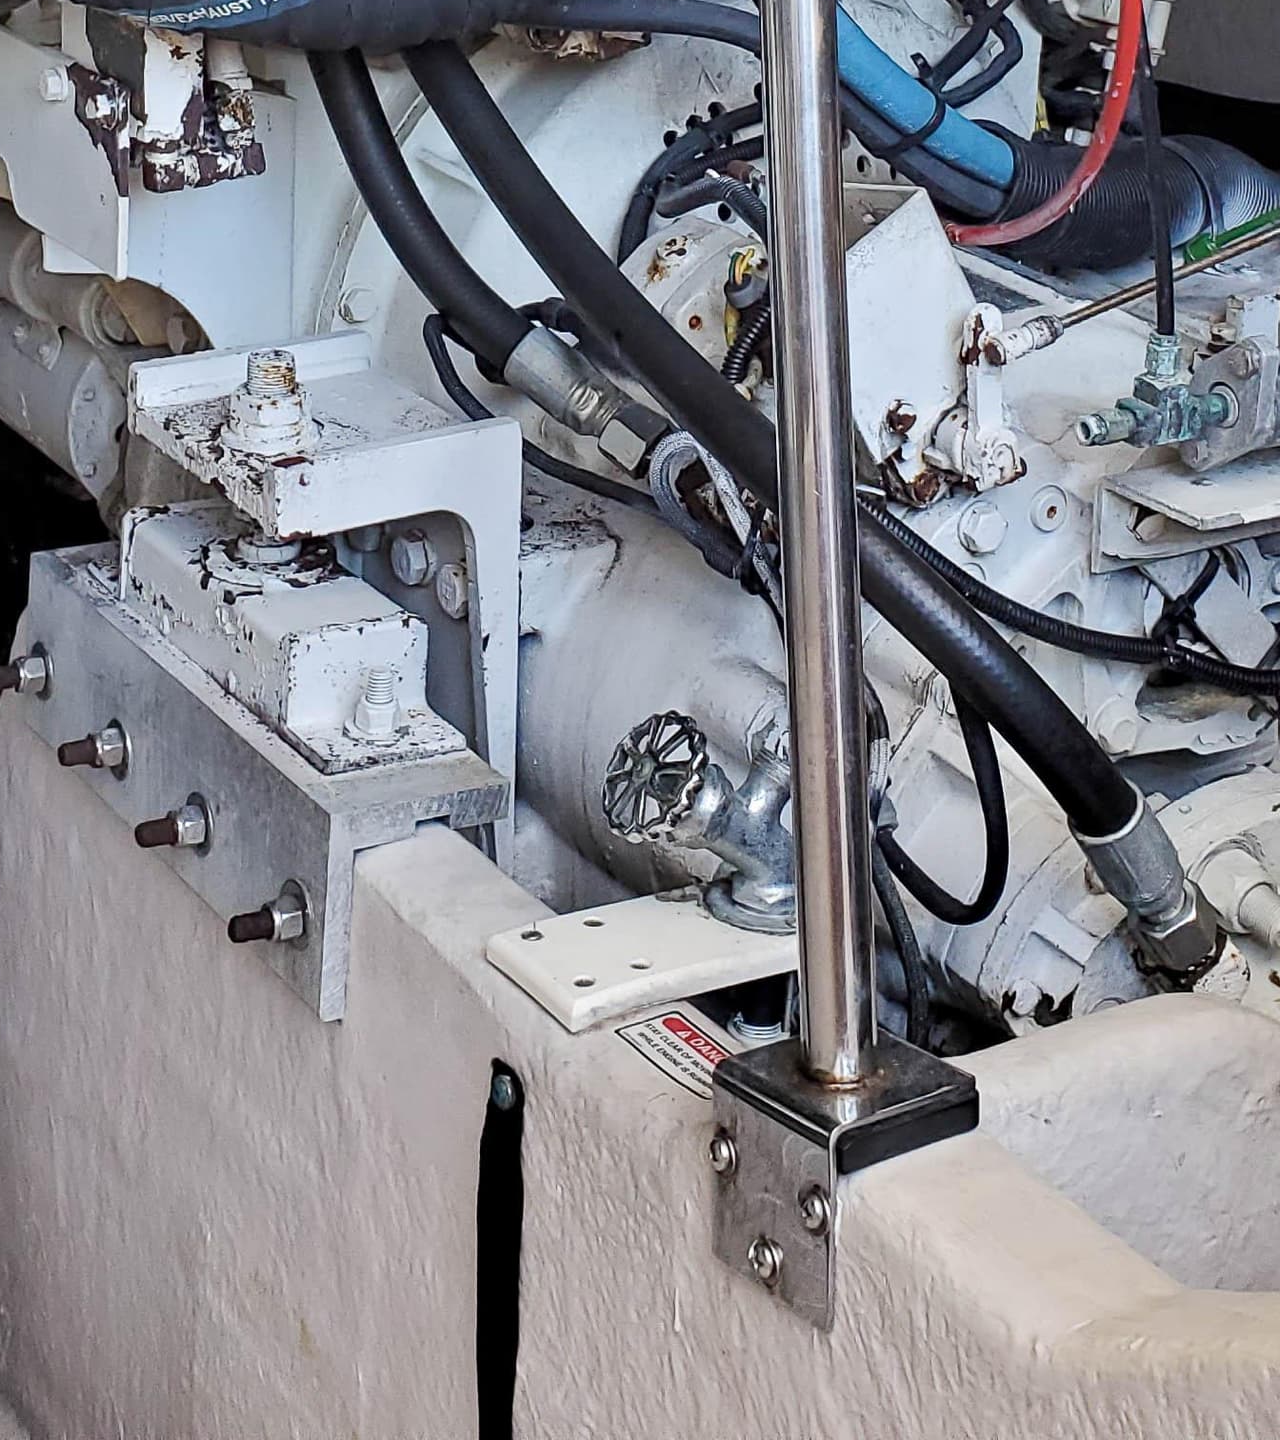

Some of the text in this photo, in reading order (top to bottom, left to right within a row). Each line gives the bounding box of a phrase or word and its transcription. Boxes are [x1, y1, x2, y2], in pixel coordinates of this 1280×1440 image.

[644, 1023, 660, 1035] STAY
[660, 1035, 684, 1054] CLEAR
[680, 1051, 694, 1060] OF
[656, 1047, 683, 1067] ENGINE
